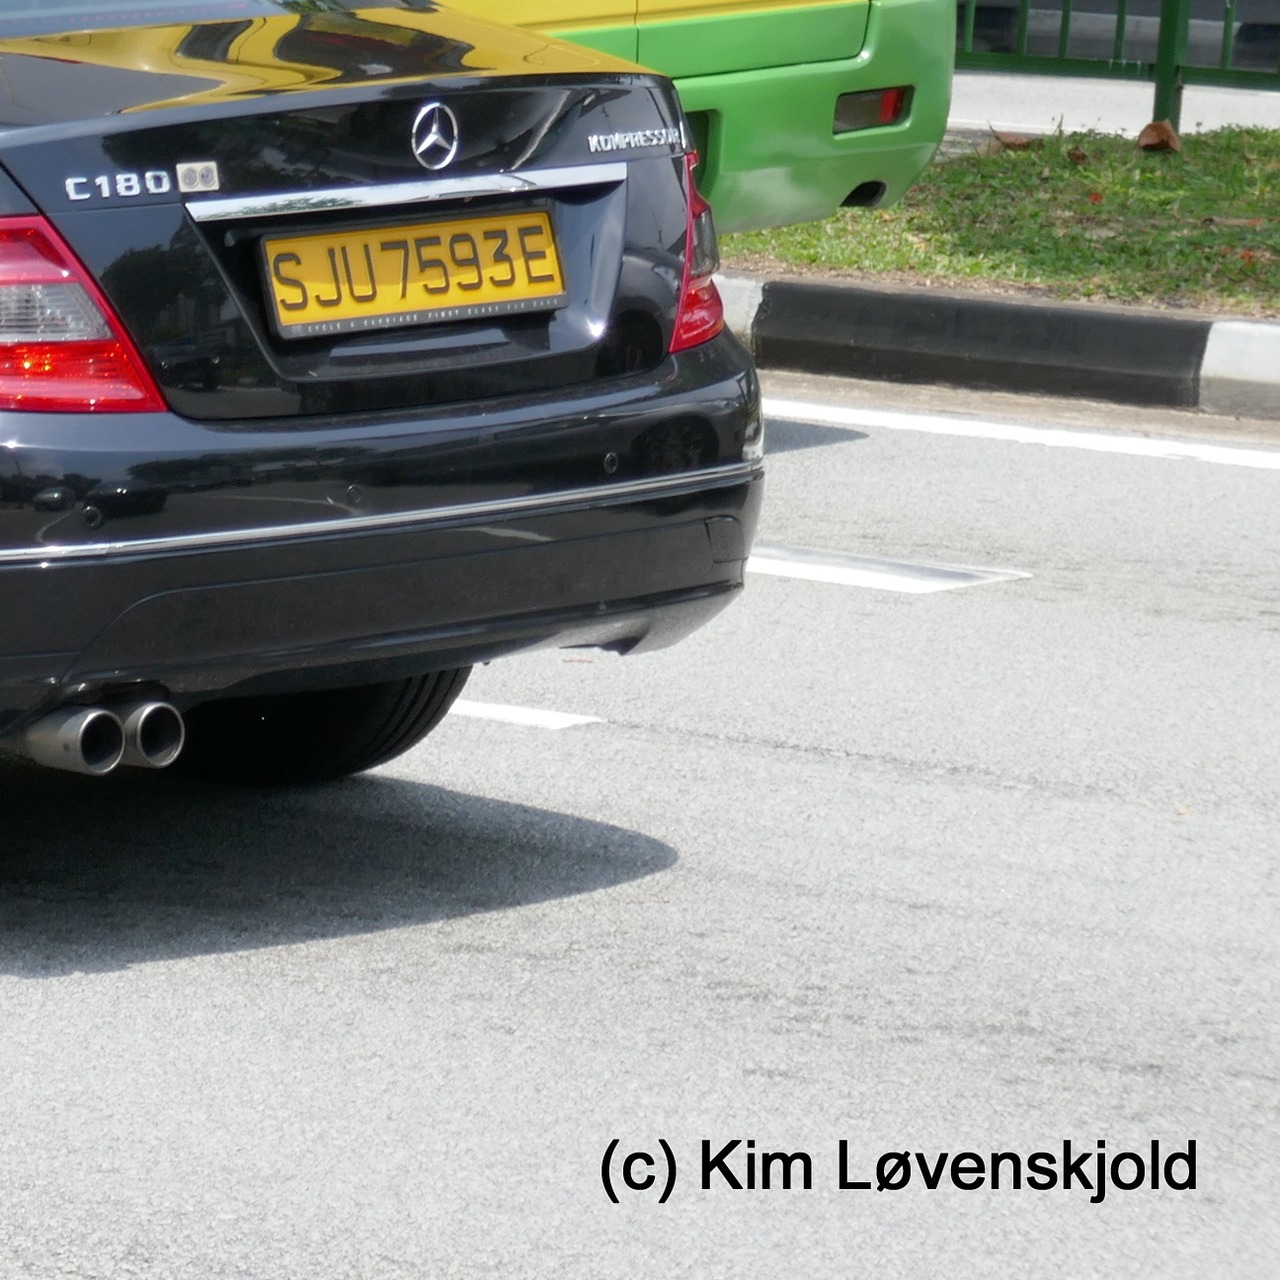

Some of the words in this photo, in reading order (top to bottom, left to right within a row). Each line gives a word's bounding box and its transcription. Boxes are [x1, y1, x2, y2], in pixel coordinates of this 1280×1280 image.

[588, 127, 680, 153] KOMPRESSOR
[65, 171, 170, 200] C180
[272, 225, 556, 311] SJU7593E
